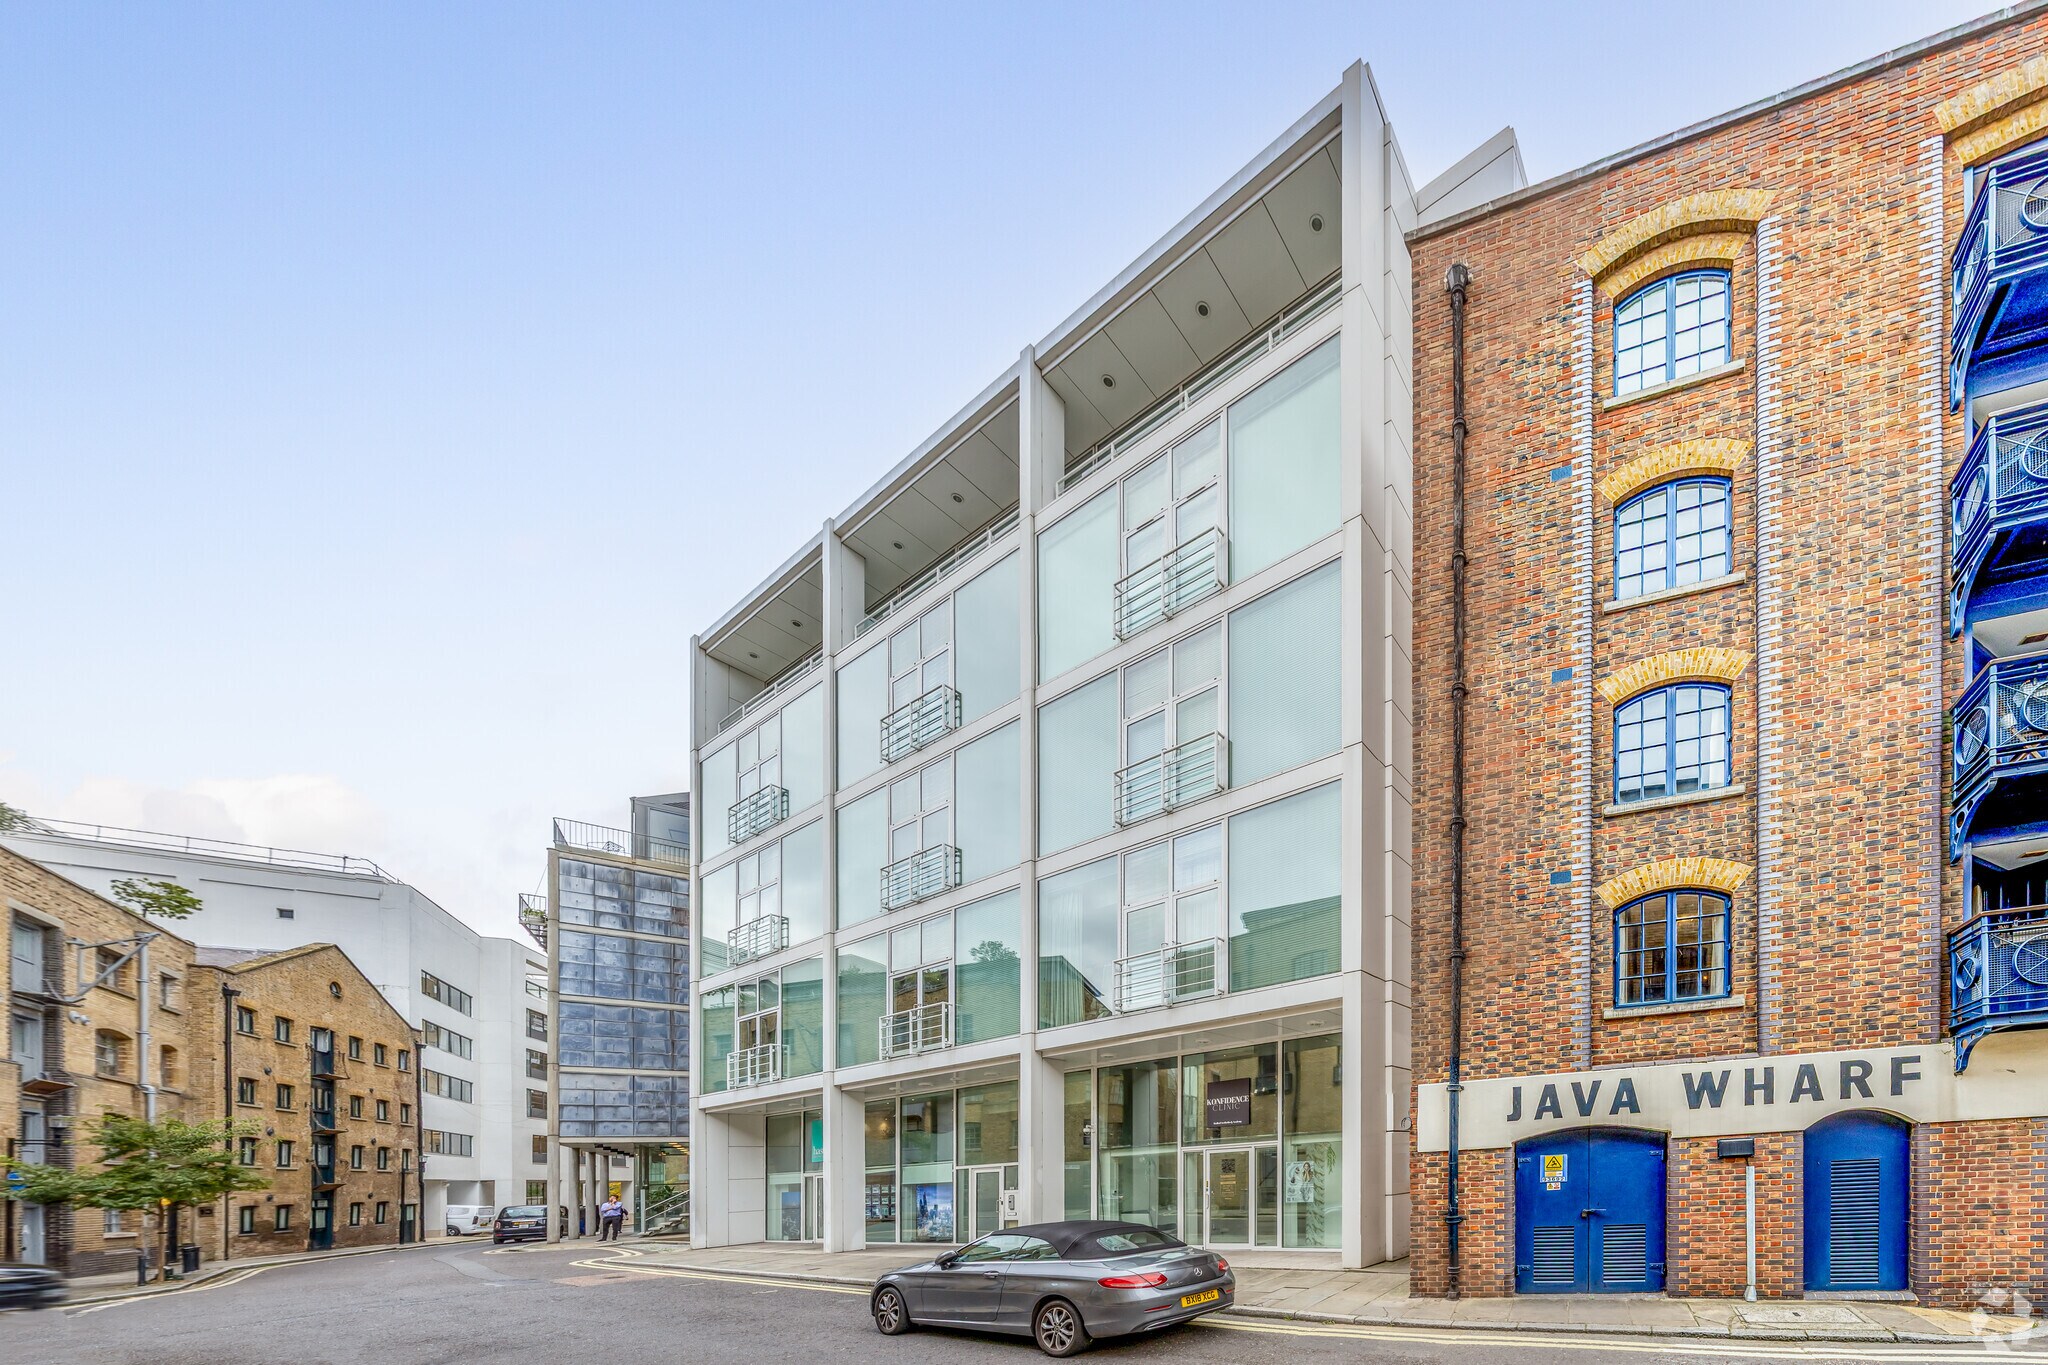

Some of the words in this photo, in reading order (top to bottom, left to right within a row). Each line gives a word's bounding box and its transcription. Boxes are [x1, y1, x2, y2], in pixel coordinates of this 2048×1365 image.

[1507, 1078, 1641, 1122] JAVA
[1681, 1055, 1921, 1110] WHARF
[1206, 1095, 1250, 1106] KONFIDENCE
[1212, 1102, 1241, 1111] CLINIC
[1185, 1293, 1202, 1305] BX18
[1202, 1290, 1216, 1301] XCG
